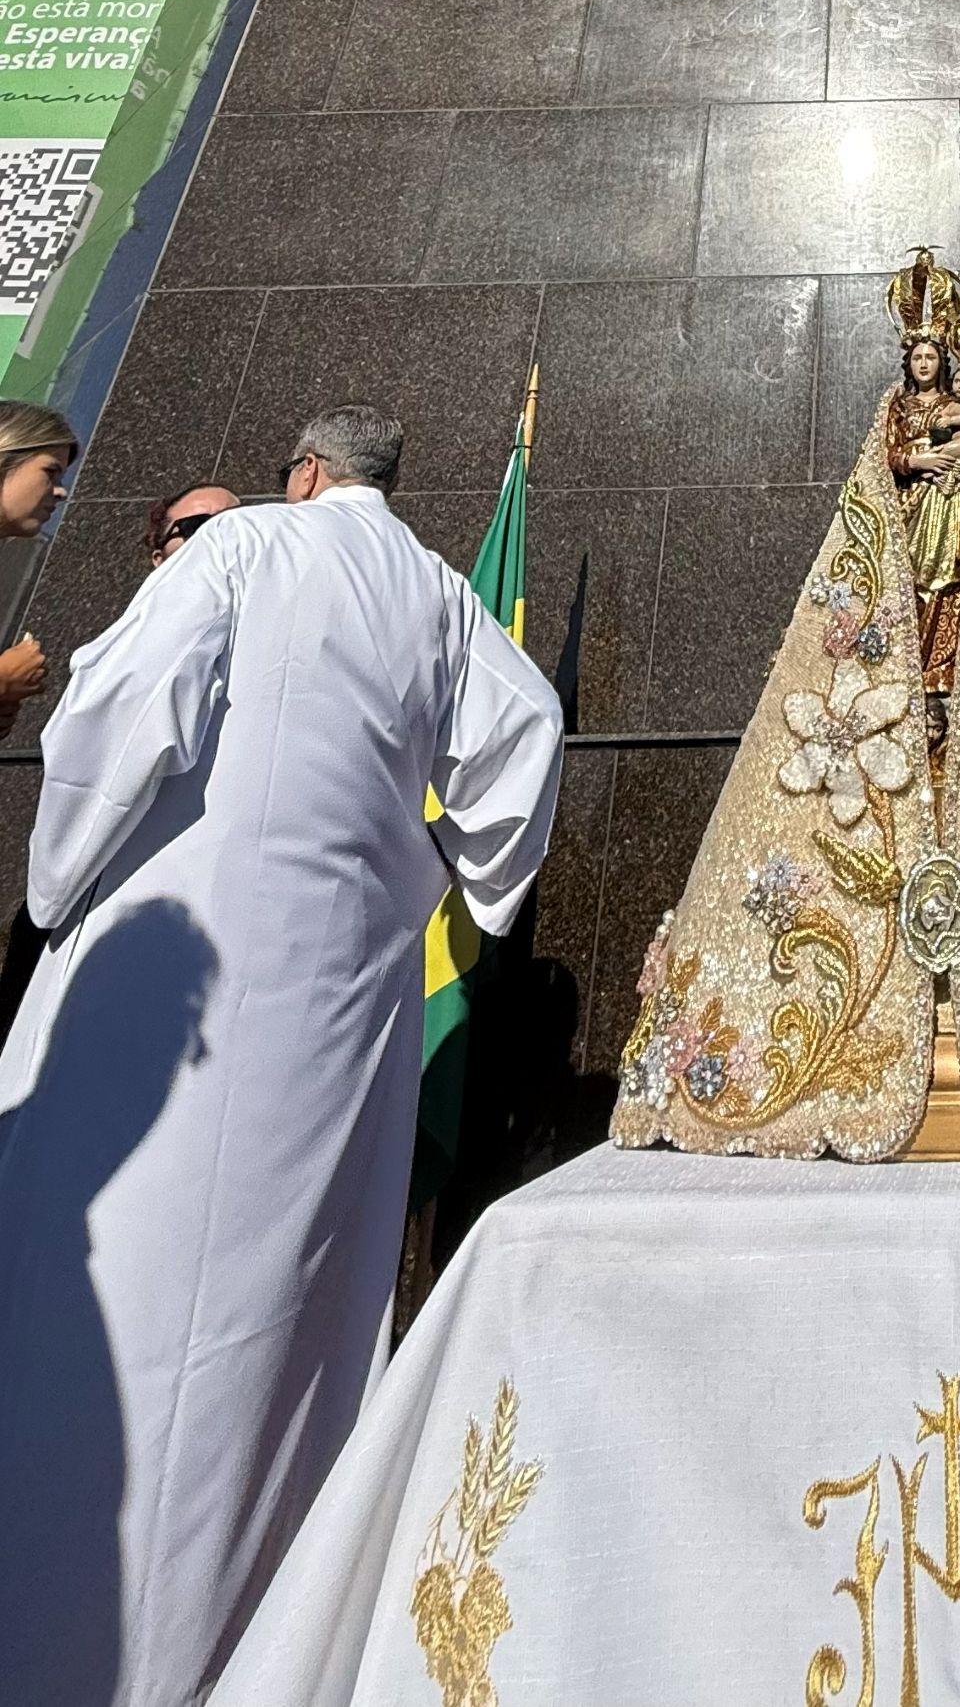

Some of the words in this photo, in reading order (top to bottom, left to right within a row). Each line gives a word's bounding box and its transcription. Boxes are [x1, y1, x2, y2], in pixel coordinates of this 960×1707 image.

[97, 1, 163, 19] mor
[0, 46, 58, 70] está
[65, 46, 140, 70] viva!
